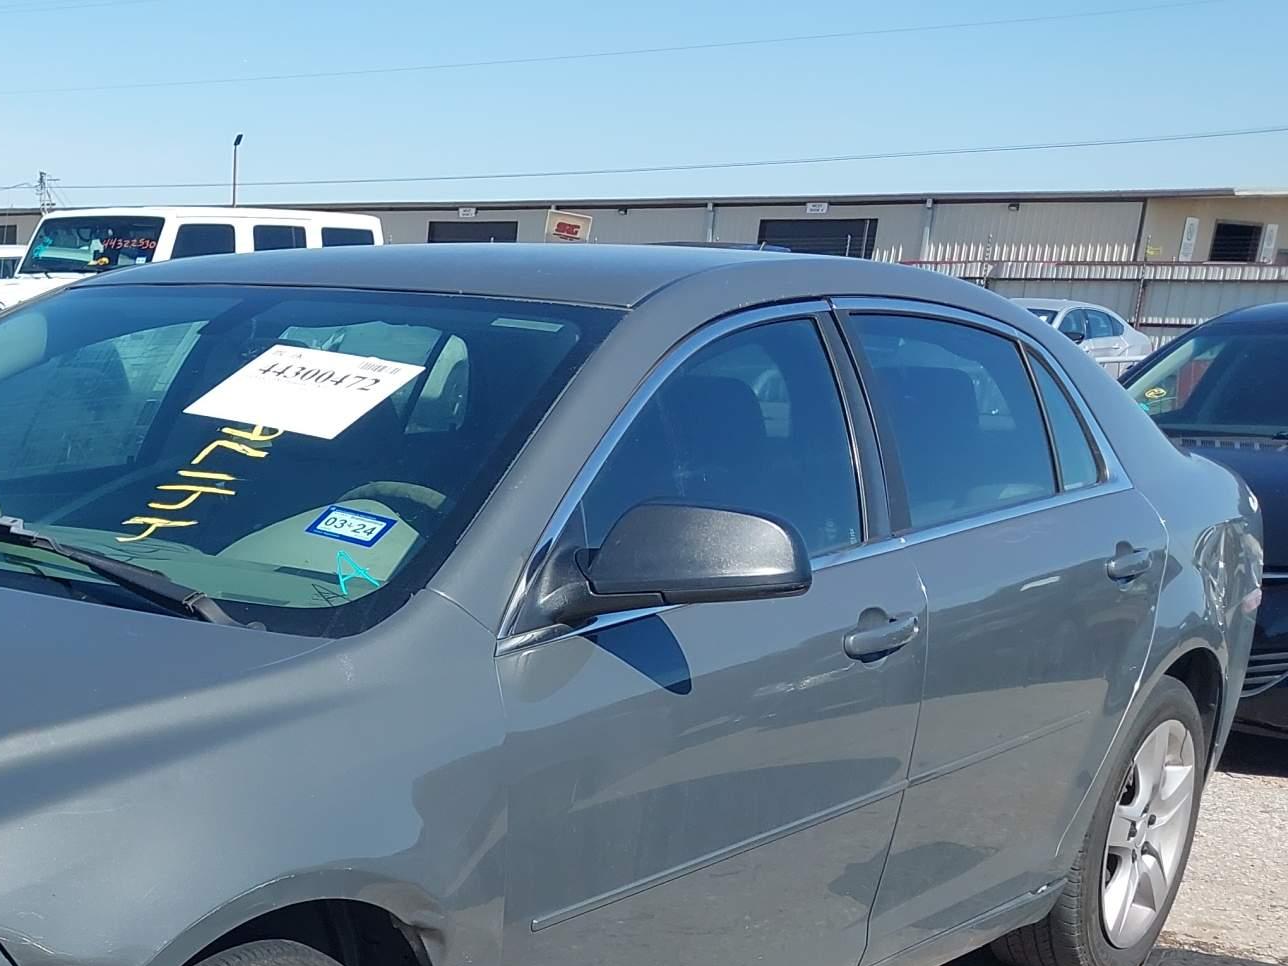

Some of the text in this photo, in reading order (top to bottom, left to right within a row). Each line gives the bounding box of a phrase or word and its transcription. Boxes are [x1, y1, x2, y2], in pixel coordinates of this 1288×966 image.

[258, 362, 381, 391] 44300472
[324, 516, 347, 530] 03
[352, 522, 378, 537] 24
[336, 549, 381, 596] A
